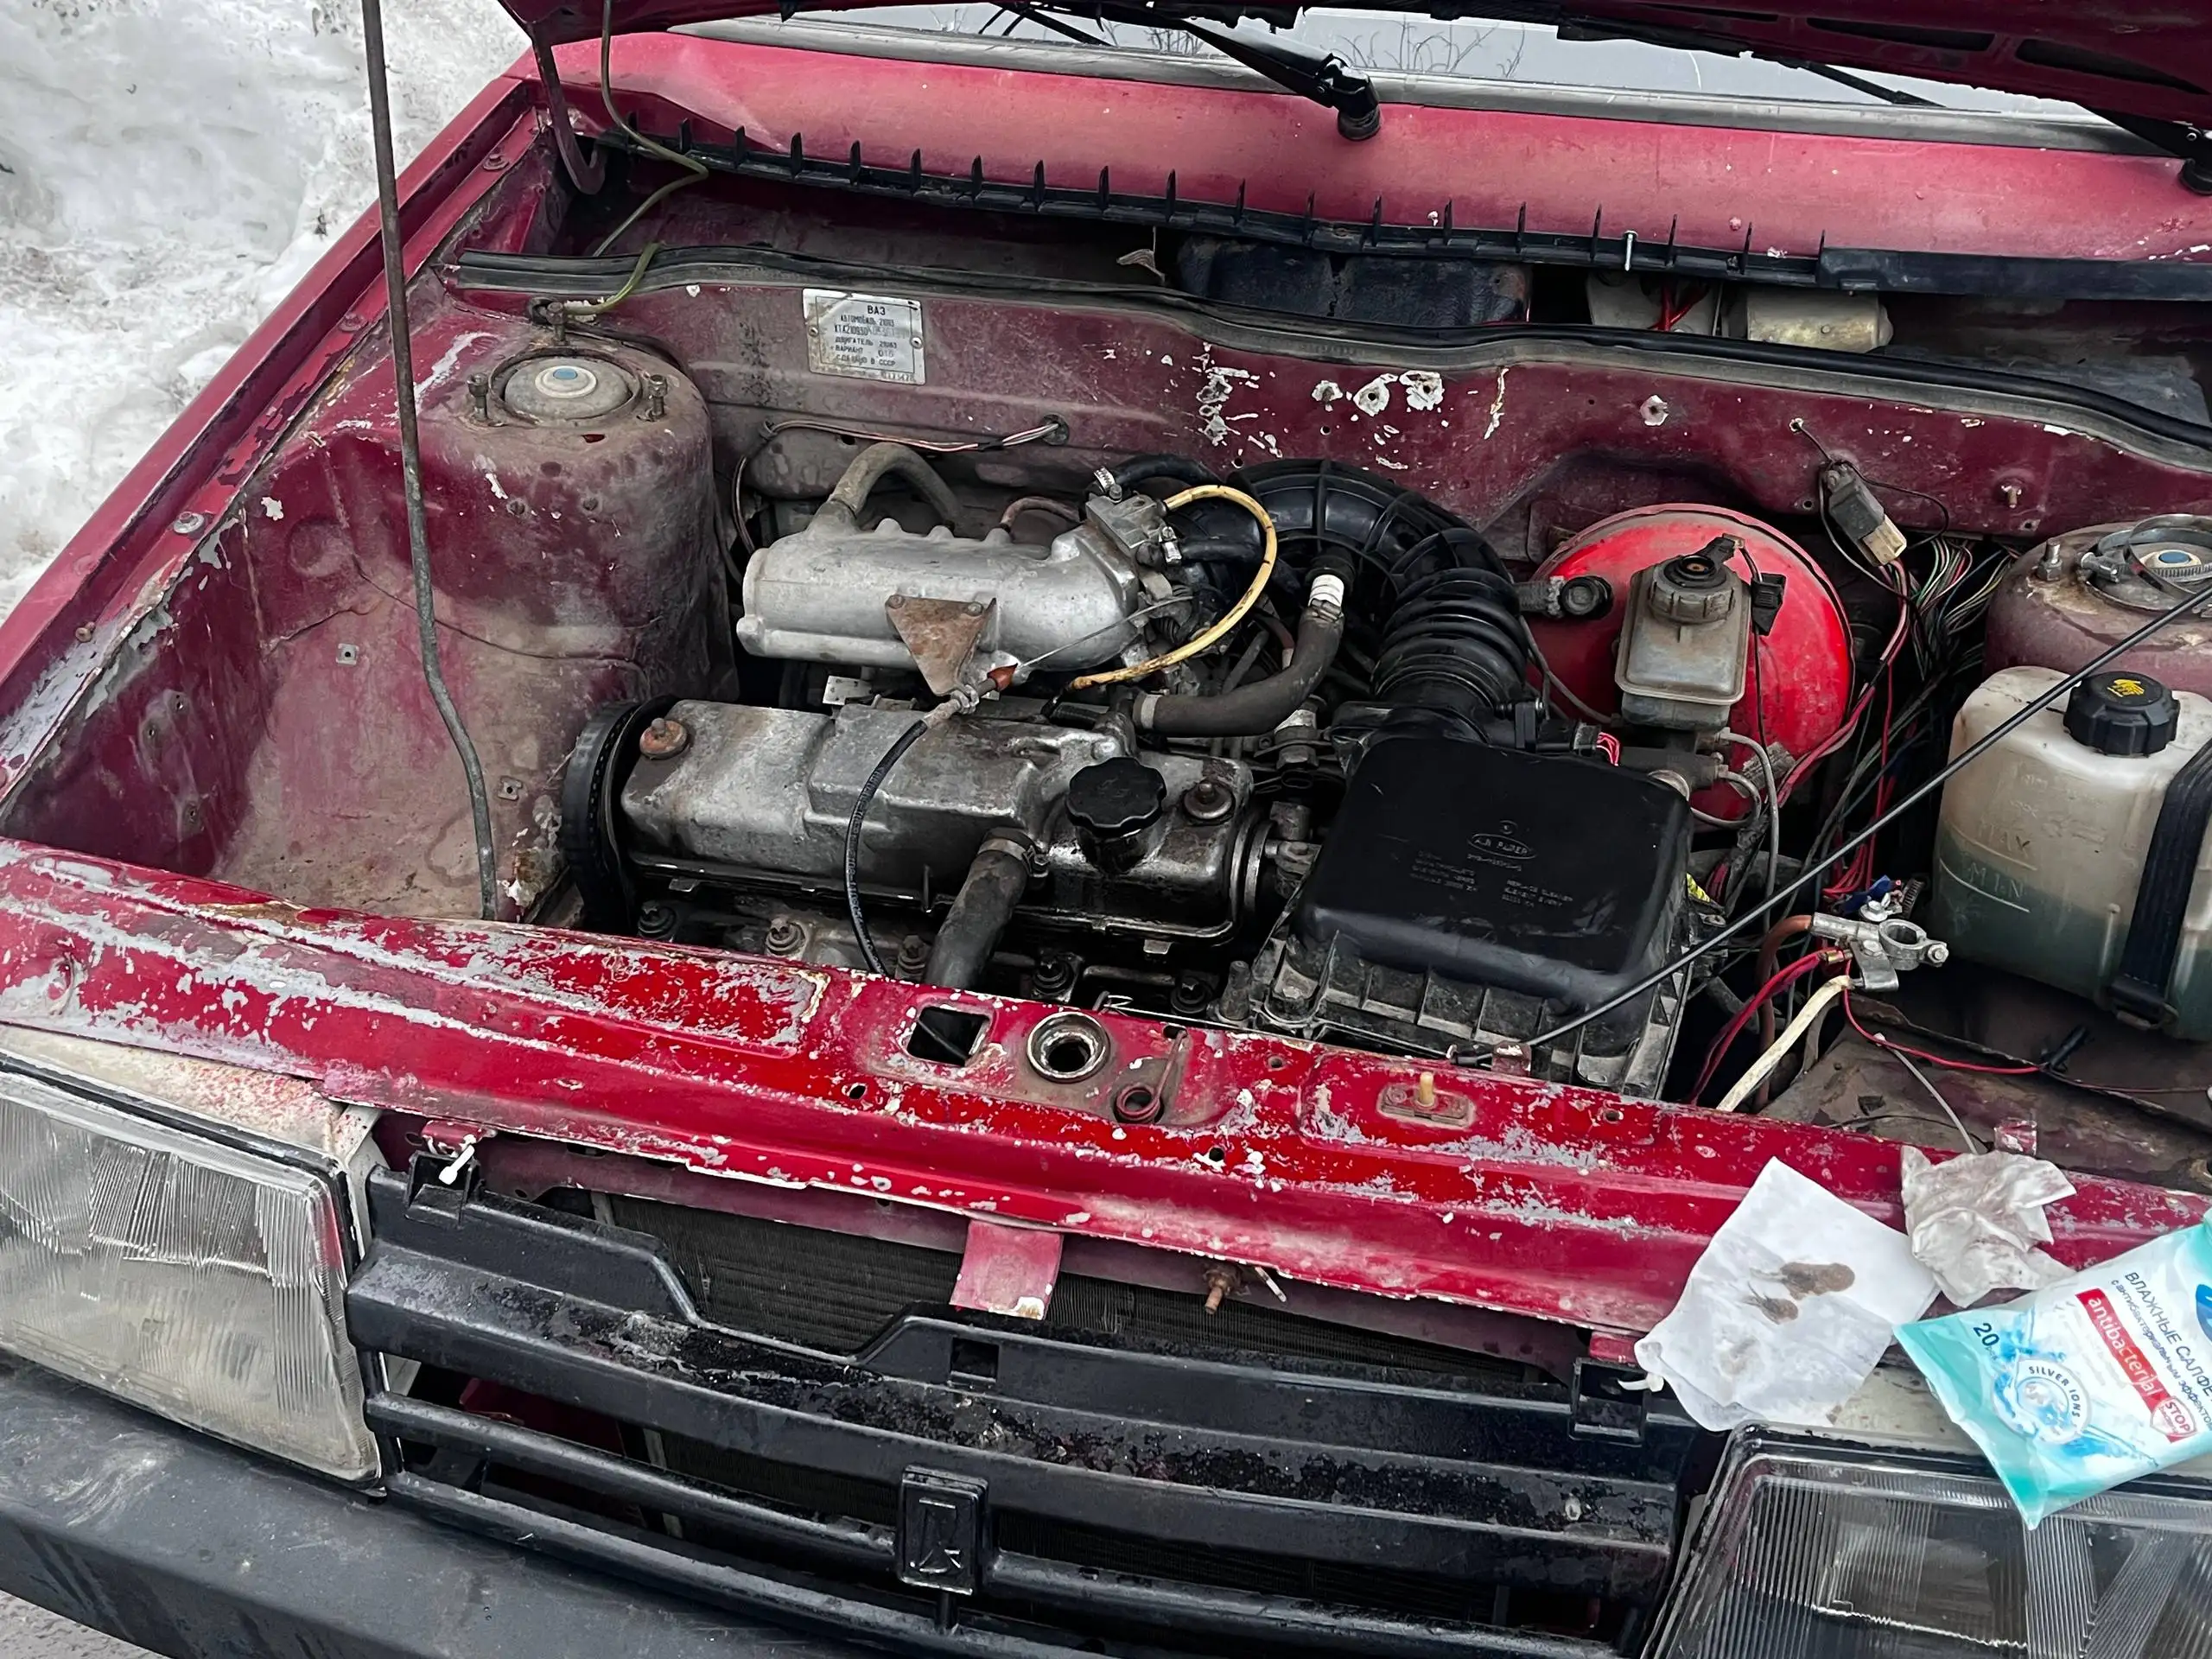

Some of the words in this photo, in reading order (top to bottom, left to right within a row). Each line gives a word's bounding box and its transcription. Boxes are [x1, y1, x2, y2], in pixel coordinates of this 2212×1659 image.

[868, 305, 886, 315] ВАЗ
[835, 336, 874, 346] ДВИГАТЕЛЬ
[835, 346, 864, 354] ВАРИАНТ
[1970, 862, 2024, 898] MIN
[1973, 1322, 2000, 1346] 20
[2088, 1296, 2164, 1396] antibacterial
[2115, 1283, 2182, 1379] антибактериальным
[2125, 1272, 2183, 1344] ВЛАЖНЫЕ
[2176, 1345, 2212, 1403] САЛФЕ
[2028, 1365, 2069, 1387] SILVER
[2069, 1389, 2082, 1418] IONS
[2164, 1401, 2192, 1433] STOP
